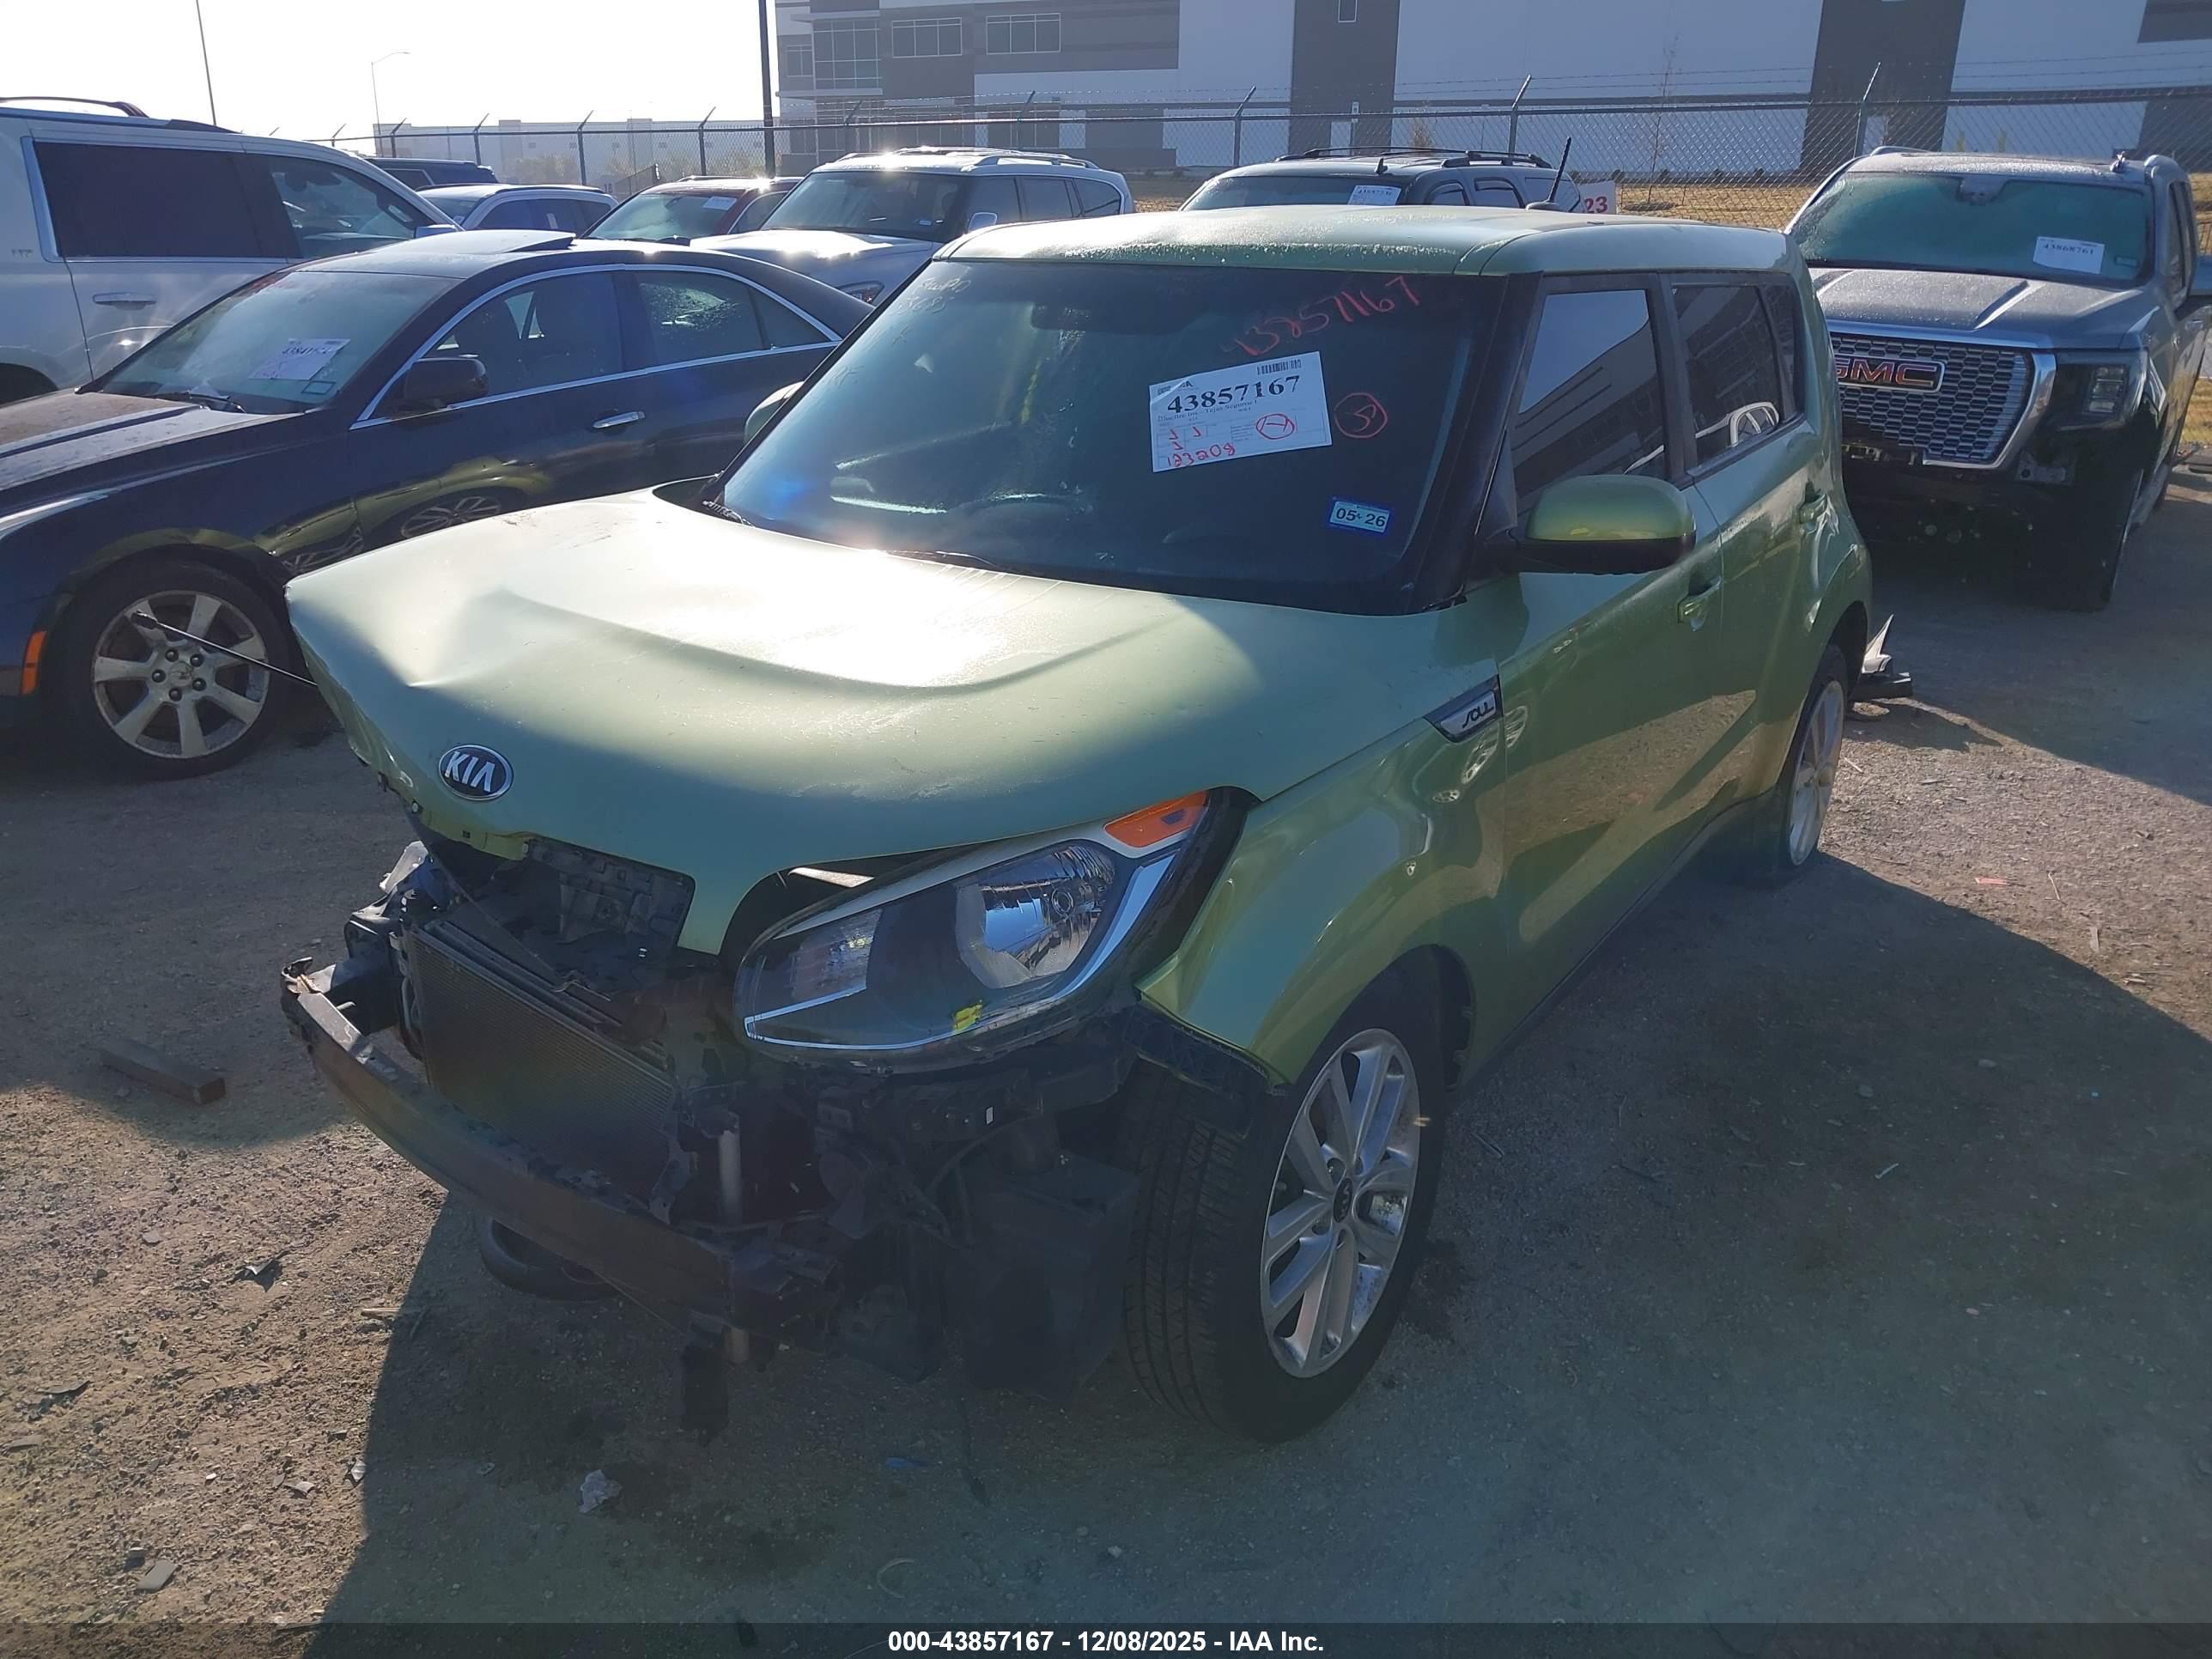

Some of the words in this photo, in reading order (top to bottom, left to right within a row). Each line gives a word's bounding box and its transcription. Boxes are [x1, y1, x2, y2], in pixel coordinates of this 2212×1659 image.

[1583, 196, 1608, 214] 23
[1167, 375, 1300, 414] 43857167
[1336, 507, 1357, 521] 05
[1364, 514, 1387, 527] 26
[445, 750, 495, 793] KIA
